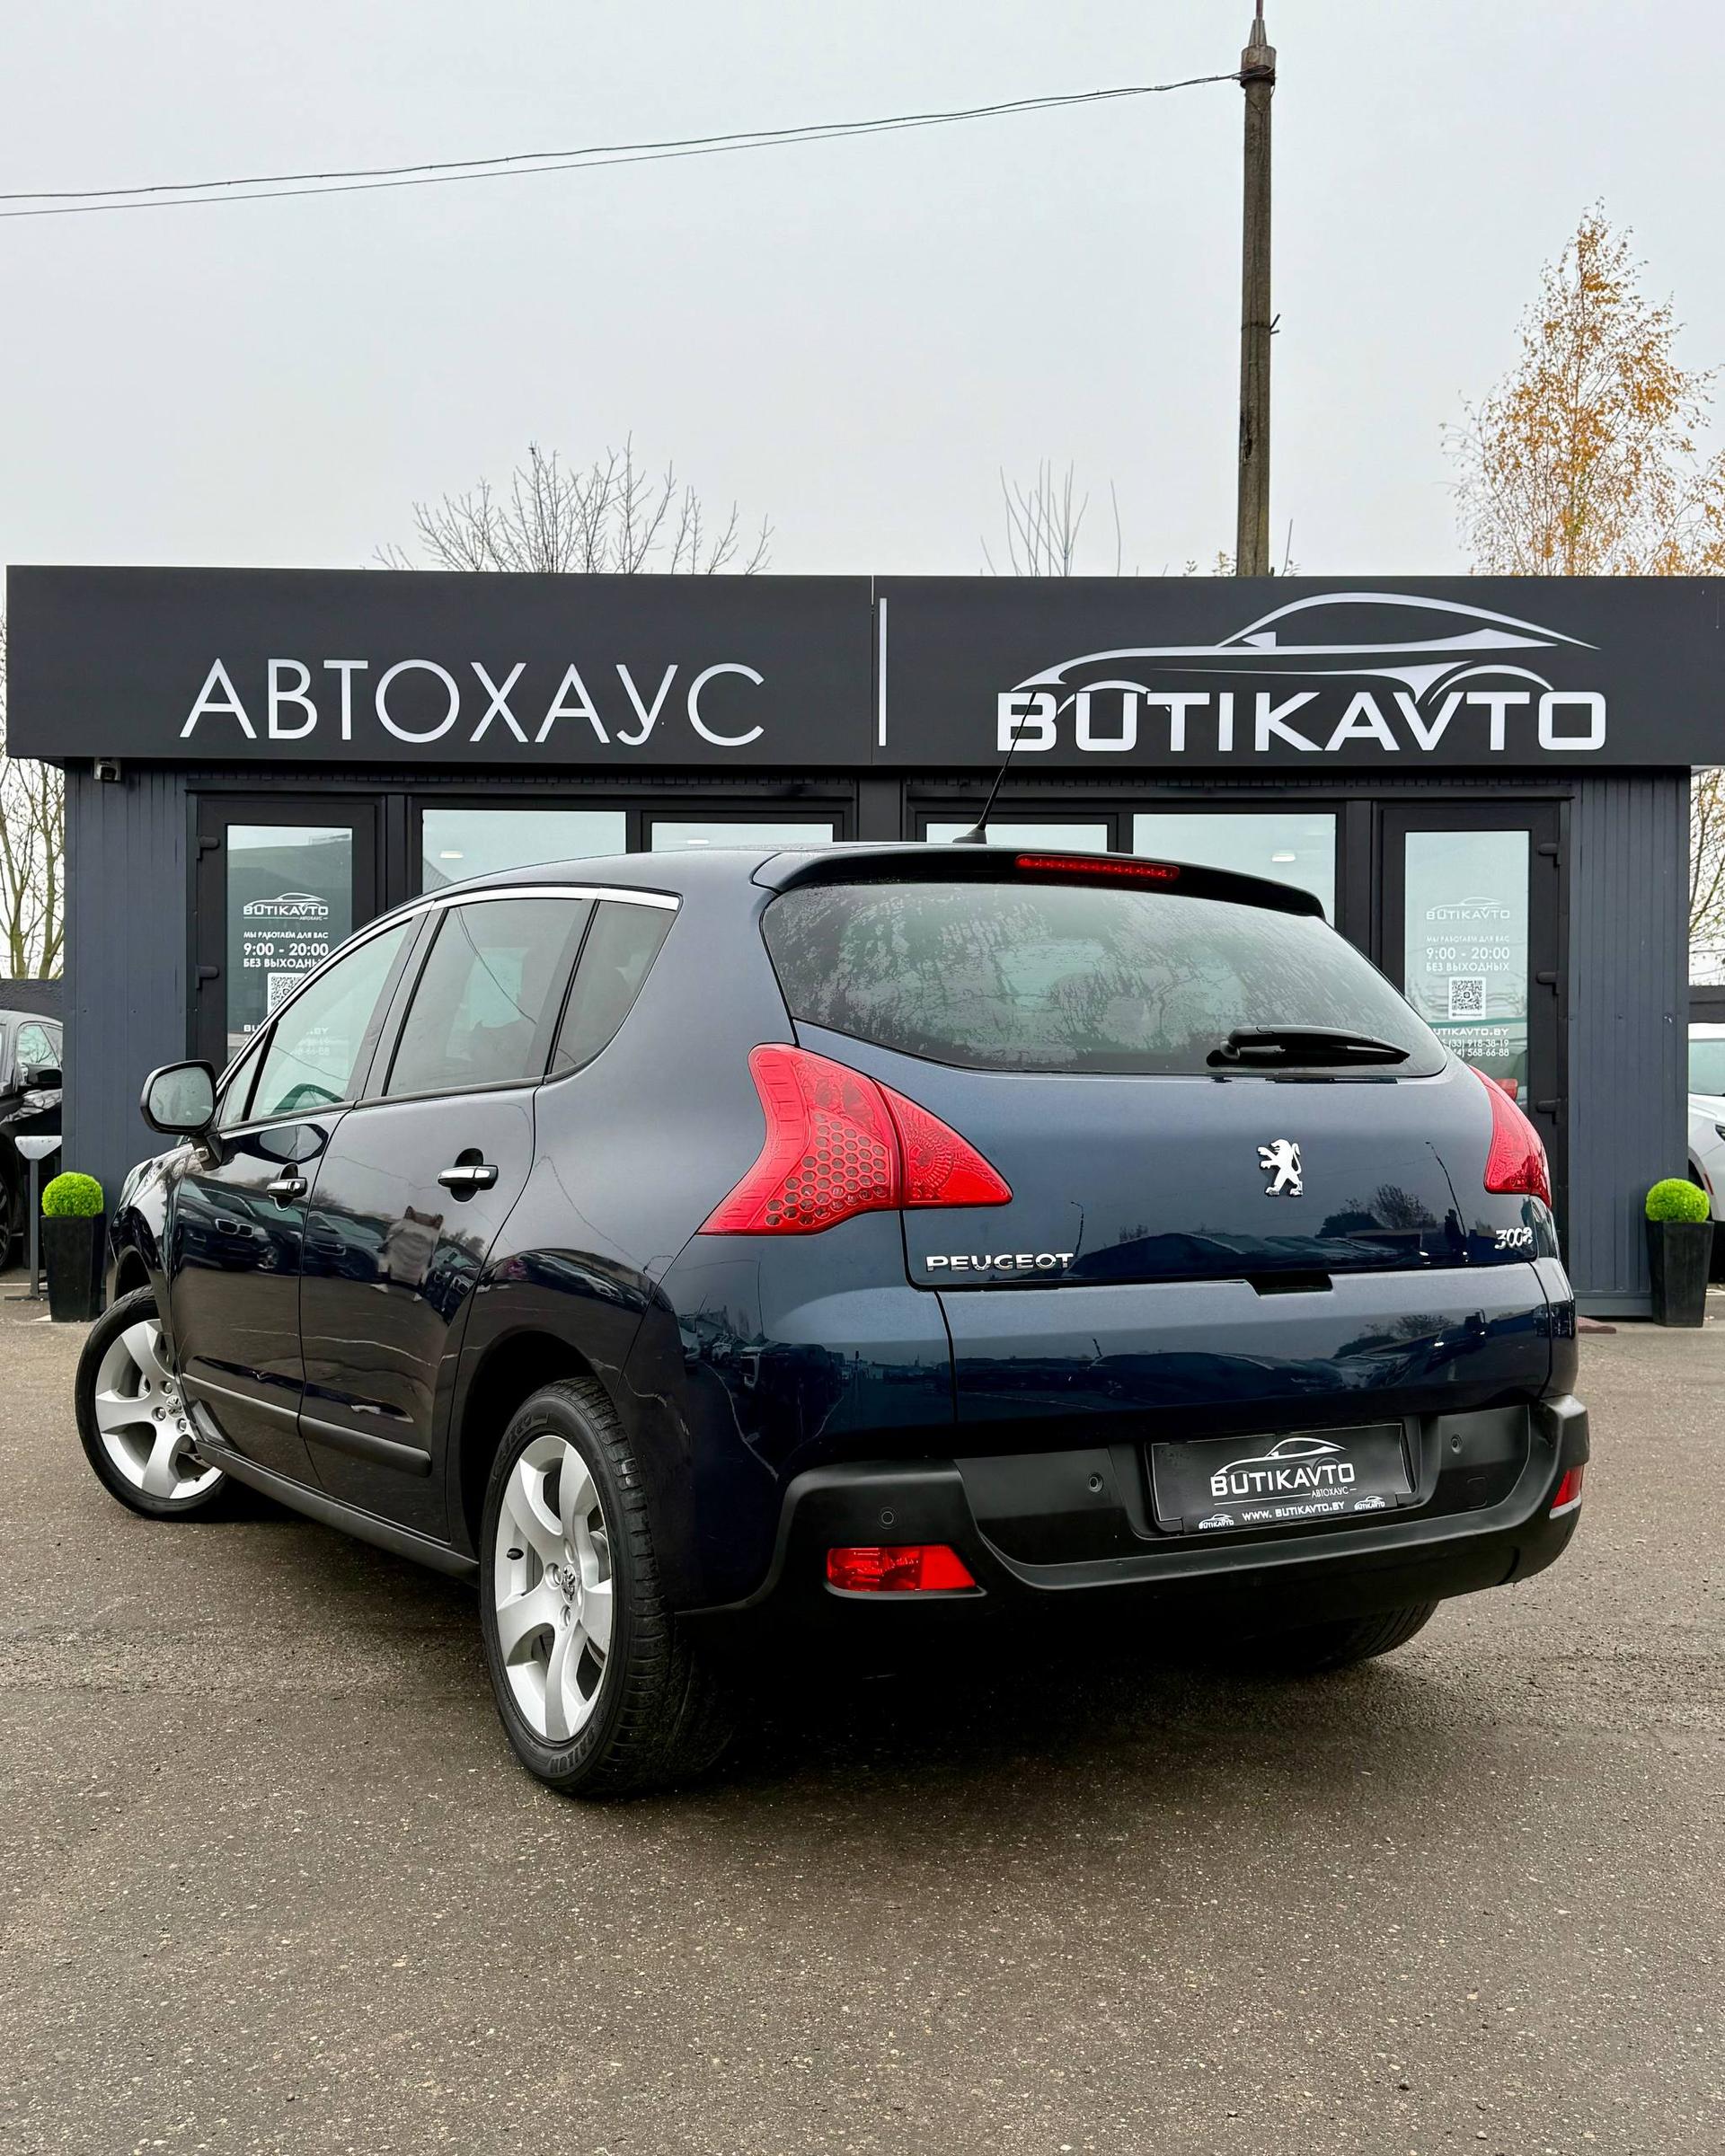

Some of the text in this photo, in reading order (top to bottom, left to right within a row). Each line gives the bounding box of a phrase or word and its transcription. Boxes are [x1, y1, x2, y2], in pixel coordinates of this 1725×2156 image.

[179, 658, 765, 747] АВТОХАУС
[996, 691, 1606, 752] BUTIKAVTO
[243, 906, 329, 915] BUTIKAVTO
[1426, 910, 1510, 920] BUTIKAVTO
[243, 943, 274, 956] 9:00
[289, 943, 329, 956] 20:00
[1426, 947, 1456, 959] 9:00
[1471, 947, 1510, 959] 20:00
[243, 959, 320, 968] БЕЗ ВЫХОДН
[1426, 962, 1509, 971] БЕЗ ВЫХОДНЫХ
[1433, 1028, 1509, 1036] UTIKAVTO.BY
[1467, 1039, 1509, 1047] 918-38-19
[1467, 1048, 1509, 1056] 568-66-88
[1494, 1226, 1534, 1250] 3008
[926, 1252, 1074, 1272] PEUGEOT
[1210, 1463, 1355, 1497] BUTIKAVTO
[1312, 1486, 1349, 1498] АВТОХАУС
[1242, 1501, 1345, 1521] WWW. BUTIKAVTO.BY
